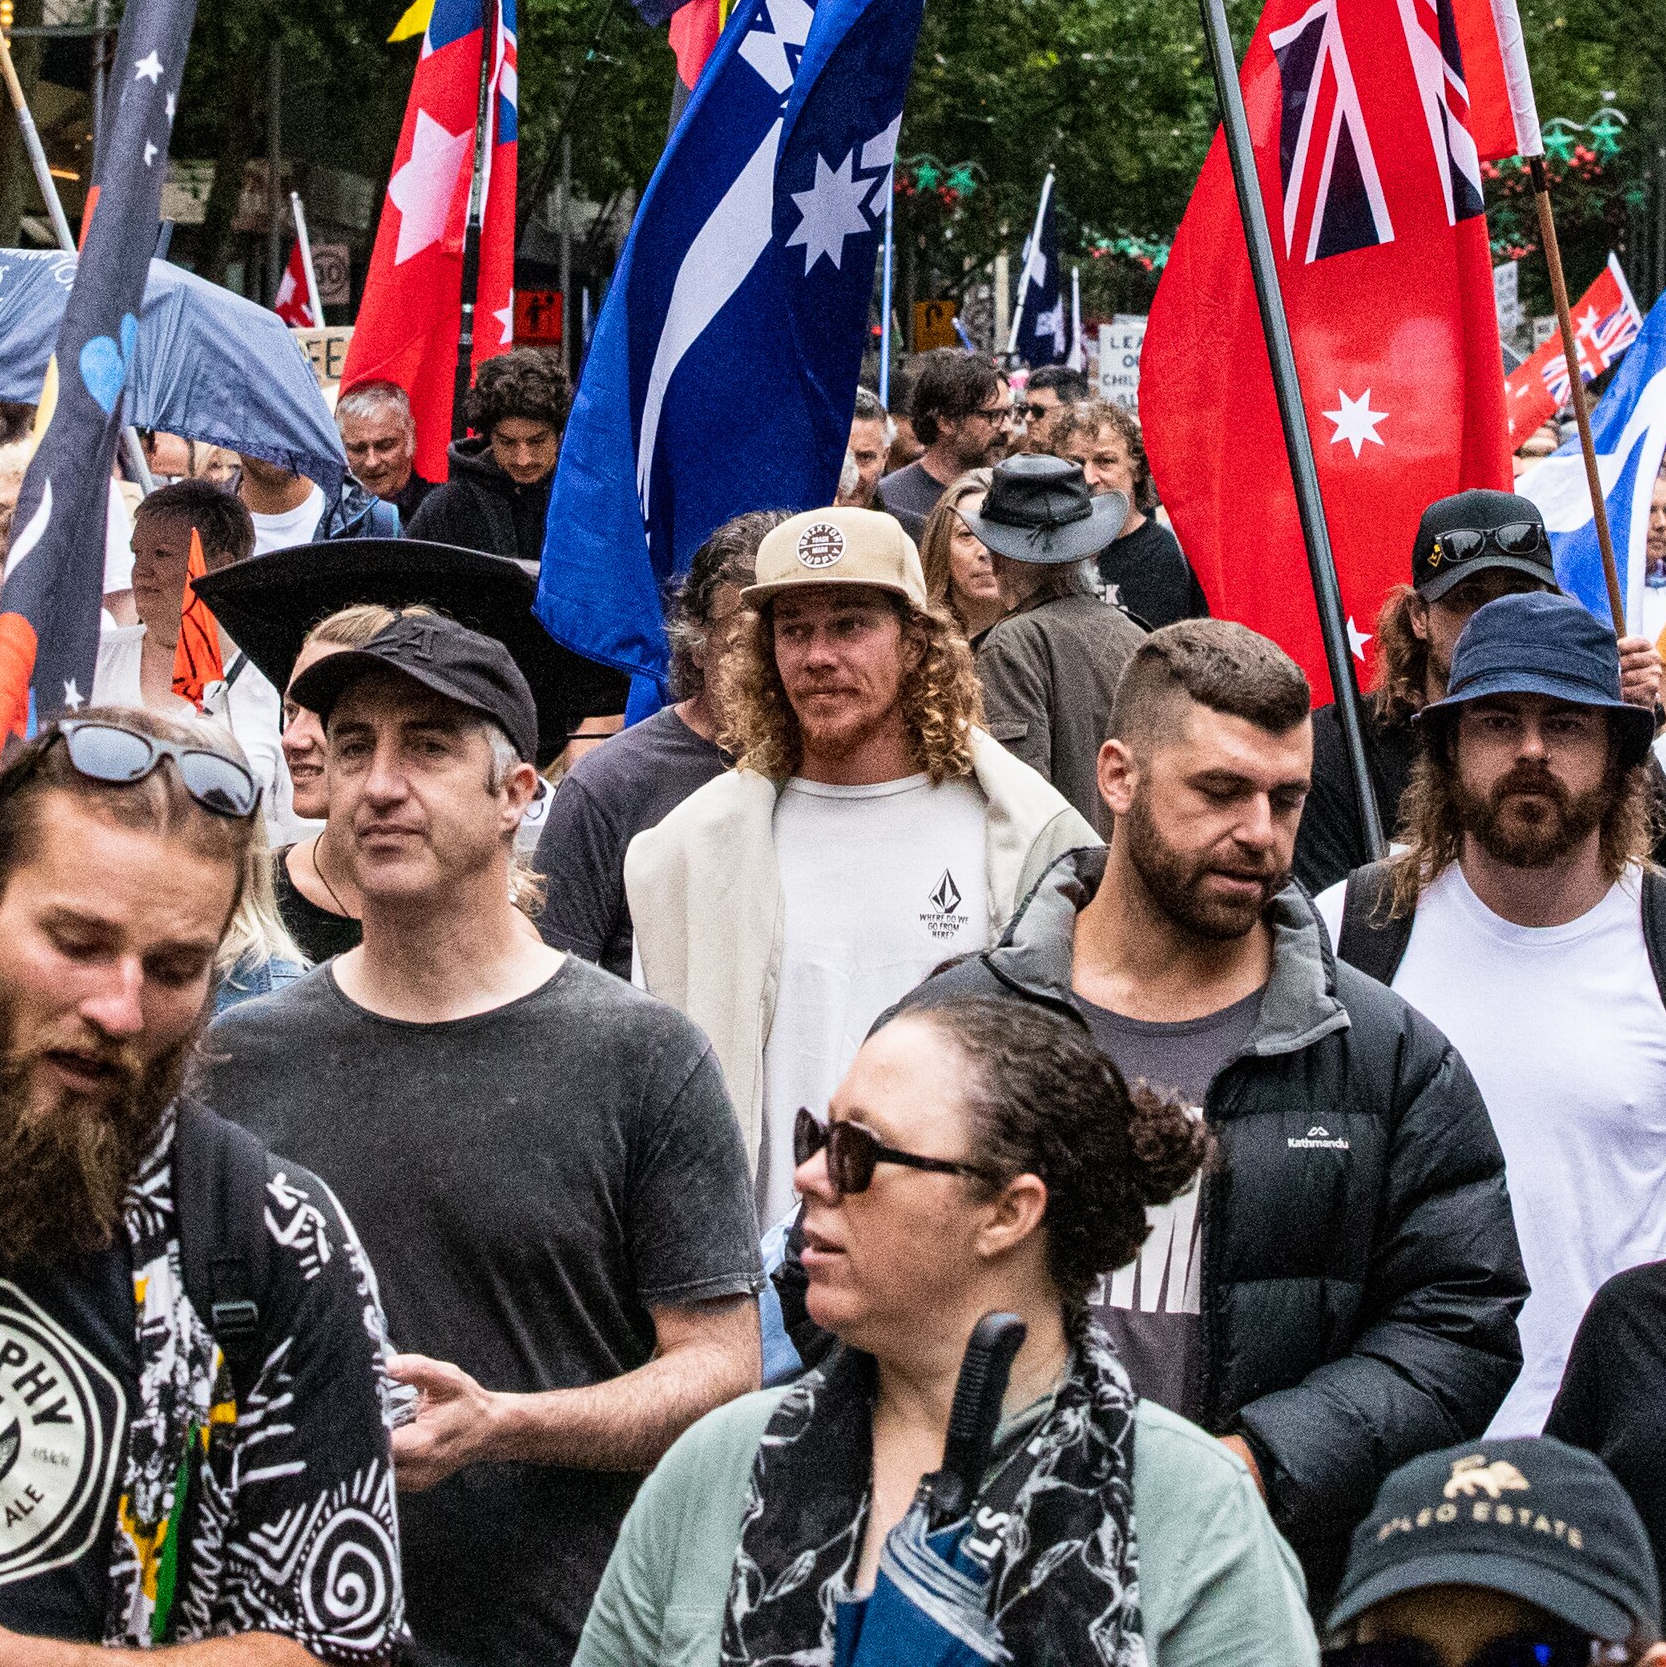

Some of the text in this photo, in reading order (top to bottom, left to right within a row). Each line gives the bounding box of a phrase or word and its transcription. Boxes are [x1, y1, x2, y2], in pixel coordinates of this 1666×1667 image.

[919, 913, 944, 922] WHERE
[946, 914, 957, 923] DO
[927, 922, 960, 932] GO FROM
[932, 930, 955, 940] HERE?
[1287, 1137, 1350, 1150] Kathmandu
[4, 1483, 46, 1529] ALE
[1471, 1501, 1583, 1550] ESTATE
